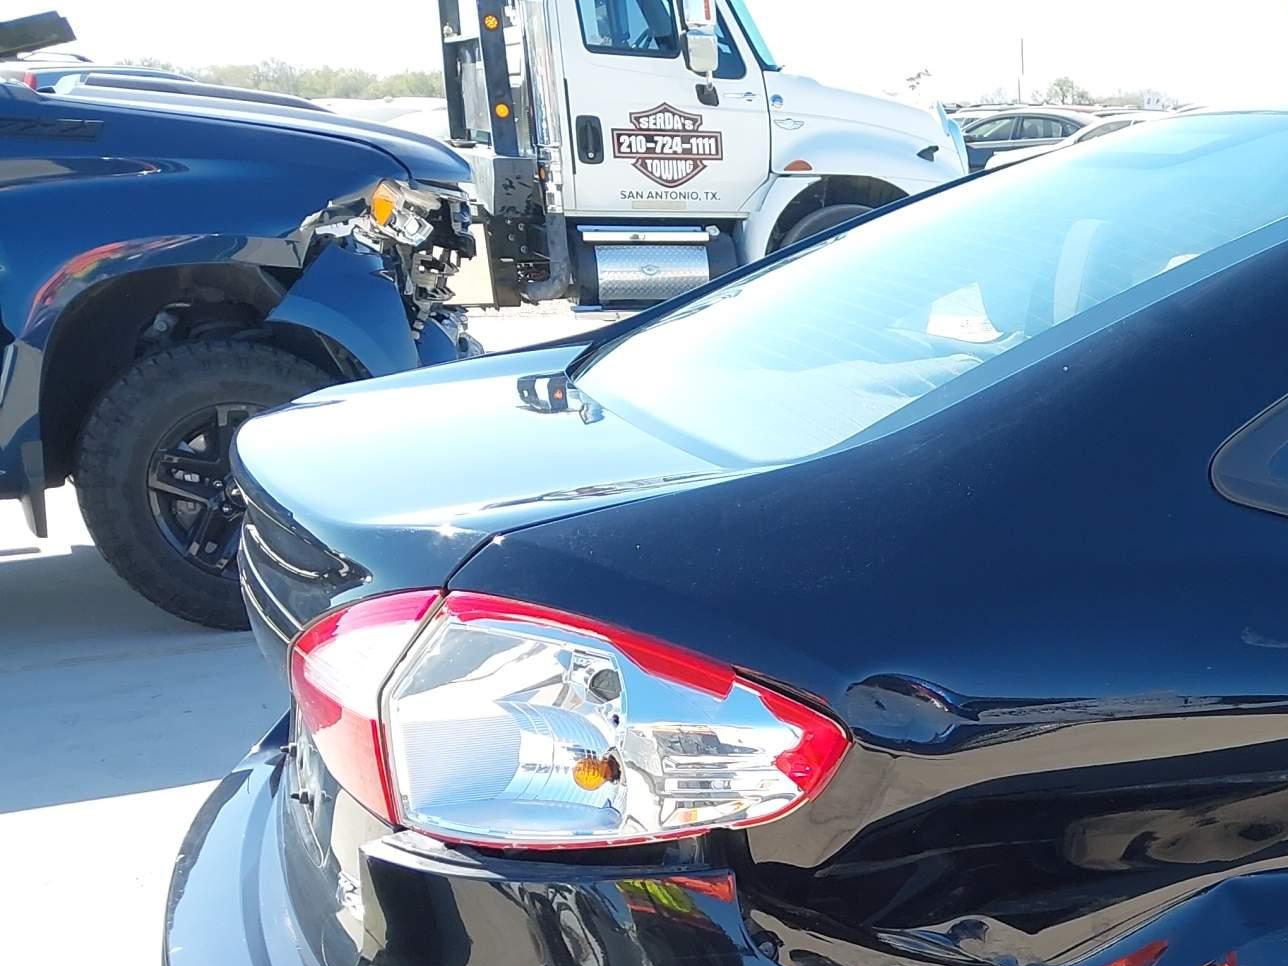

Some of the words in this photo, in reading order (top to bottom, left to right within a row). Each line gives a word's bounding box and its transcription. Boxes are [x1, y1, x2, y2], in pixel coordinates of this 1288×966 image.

[639, 111, 693, 130] SERDA'S
[619, 136, 716, 155] 210-724-1111
[645, 159, 694, 181] TOWING
[620, 190, 644, 200] SAN
[647, 190, 702, 201] ANTONIO,
[704, 191, 721, 202] TX.
